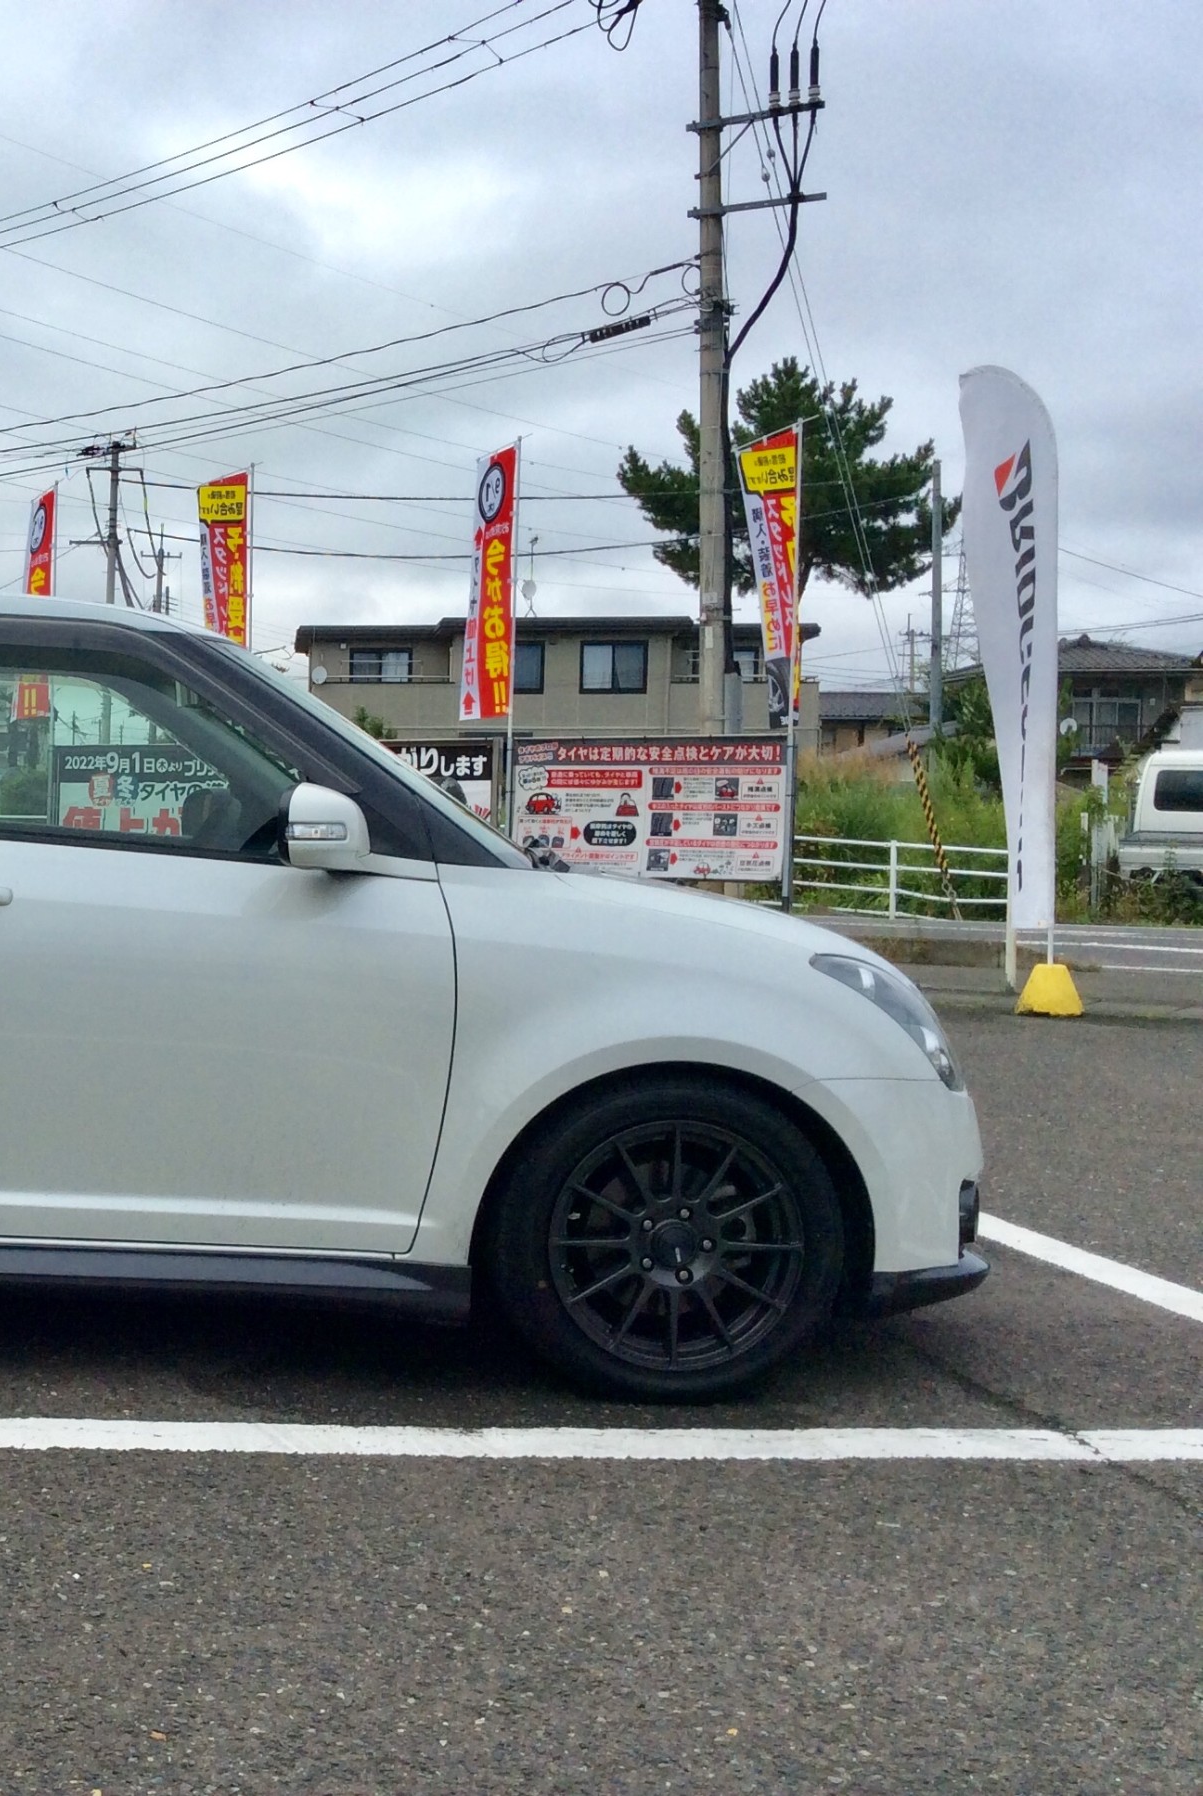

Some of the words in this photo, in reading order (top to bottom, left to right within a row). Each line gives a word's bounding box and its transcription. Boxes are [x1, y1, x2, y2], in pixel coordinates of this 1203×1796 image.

[557, 745, 781, 762] タイヤは定期的な安全点検とケアが大切!
[997, 438, 1036, 893] BRIDGE
